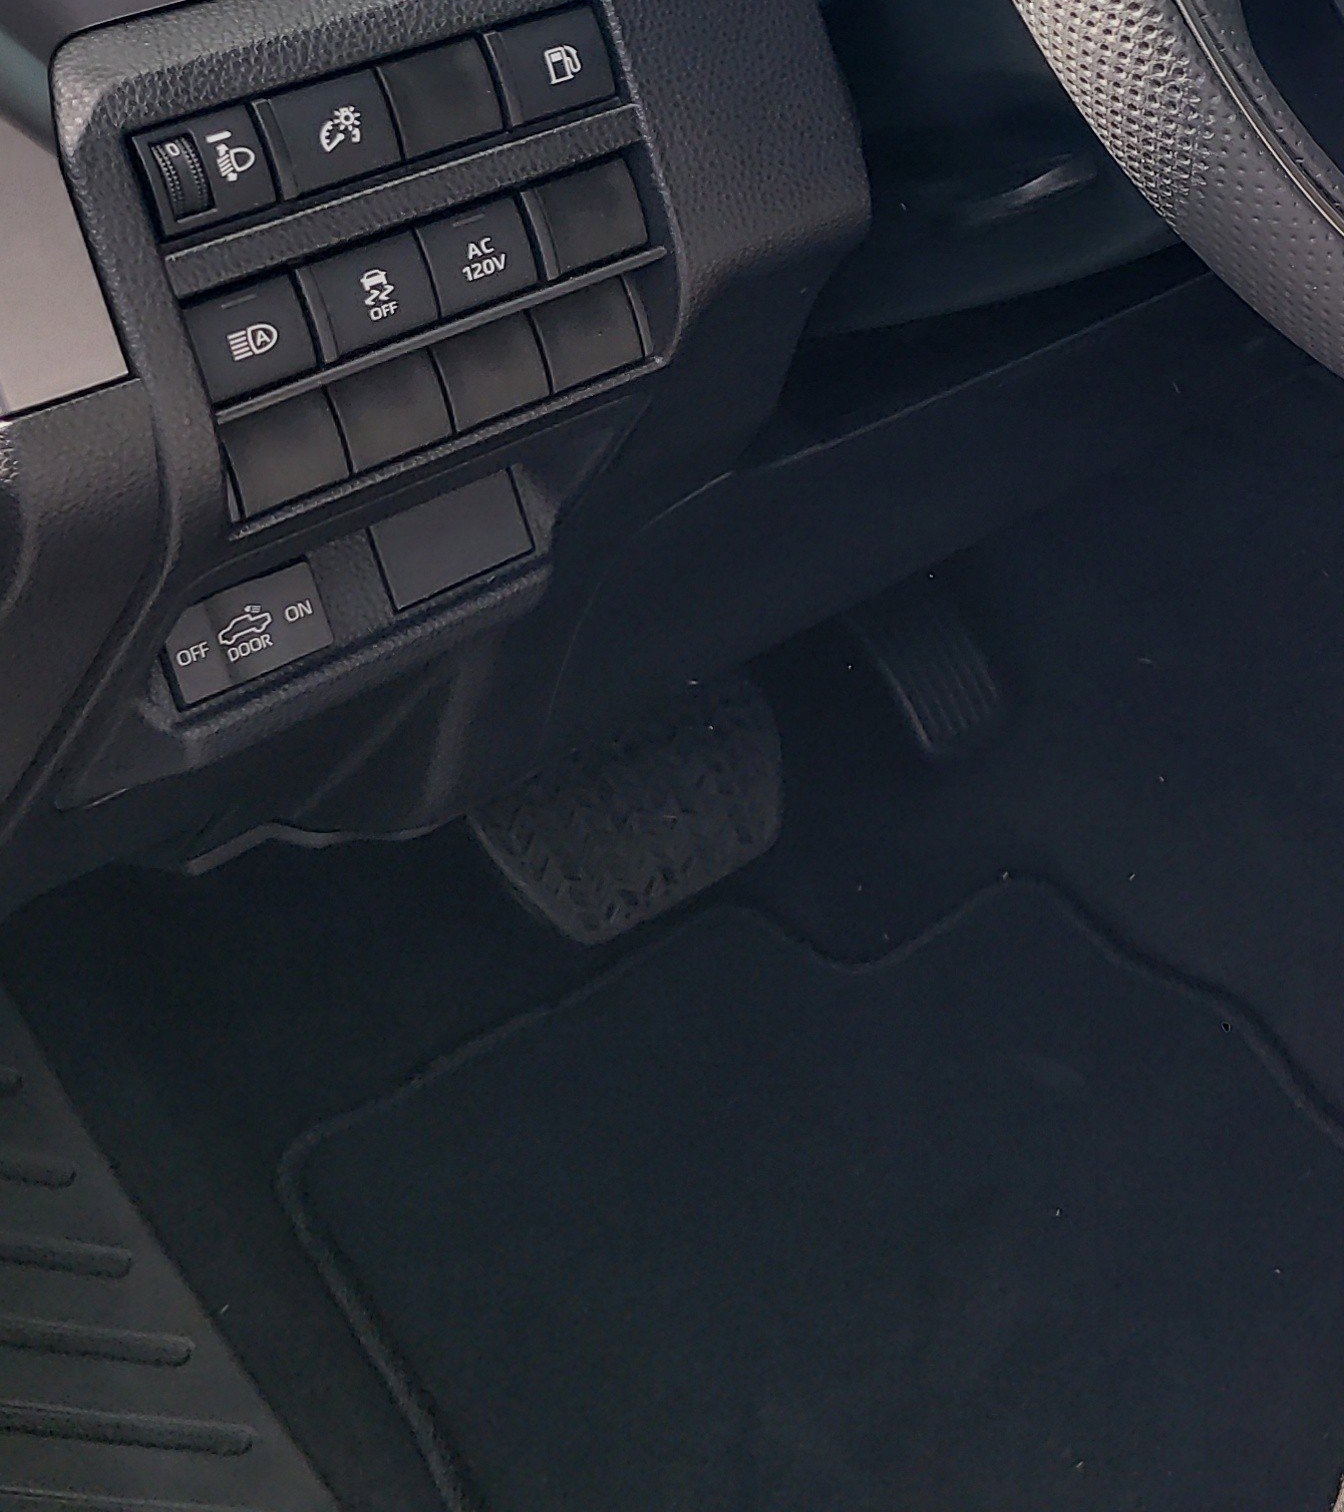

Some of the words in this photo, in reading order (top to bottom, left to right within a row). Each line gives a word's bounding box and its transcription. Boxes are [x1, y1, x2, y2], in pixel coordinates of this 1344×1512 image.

[467, 237, 495, 260] AC
[461, 253, 507, 282] 120V
[369, 300, 399, 322] OFF
[284, 599, 313, 623] ON
[176, 641, 210, 667] OFF
[227, 634, 274, 663] DOOR
